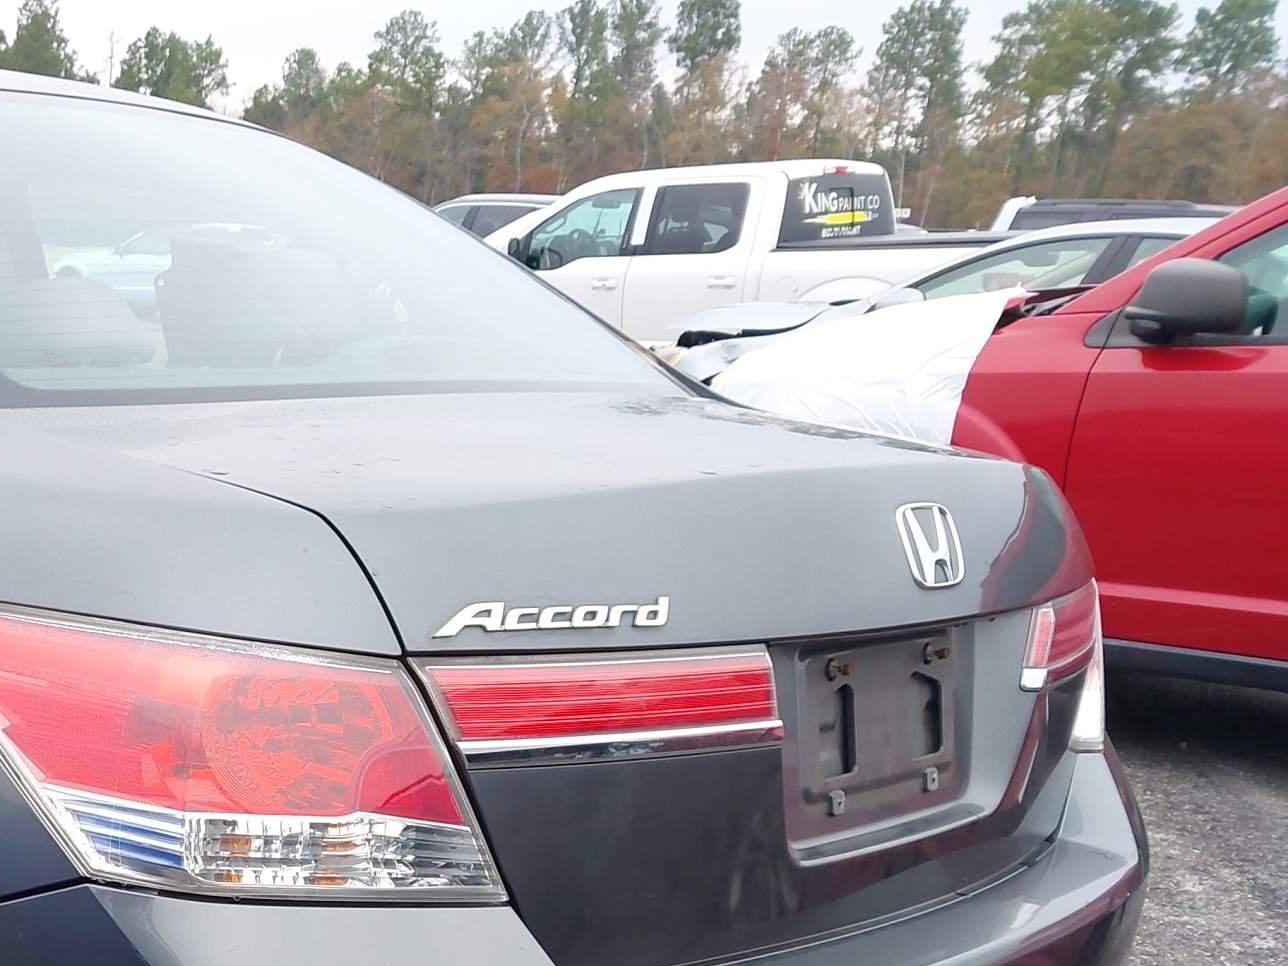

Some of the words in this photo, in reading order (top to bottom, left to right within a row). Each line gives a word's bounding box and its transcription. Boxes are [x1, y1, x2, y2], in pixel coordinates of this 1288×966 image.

[804, 182, 838, 212] KING
[838, 195, 866, 210] PAINT
[867, 194, 880, 209] CO
[431, 596, 670, 639] Accord
